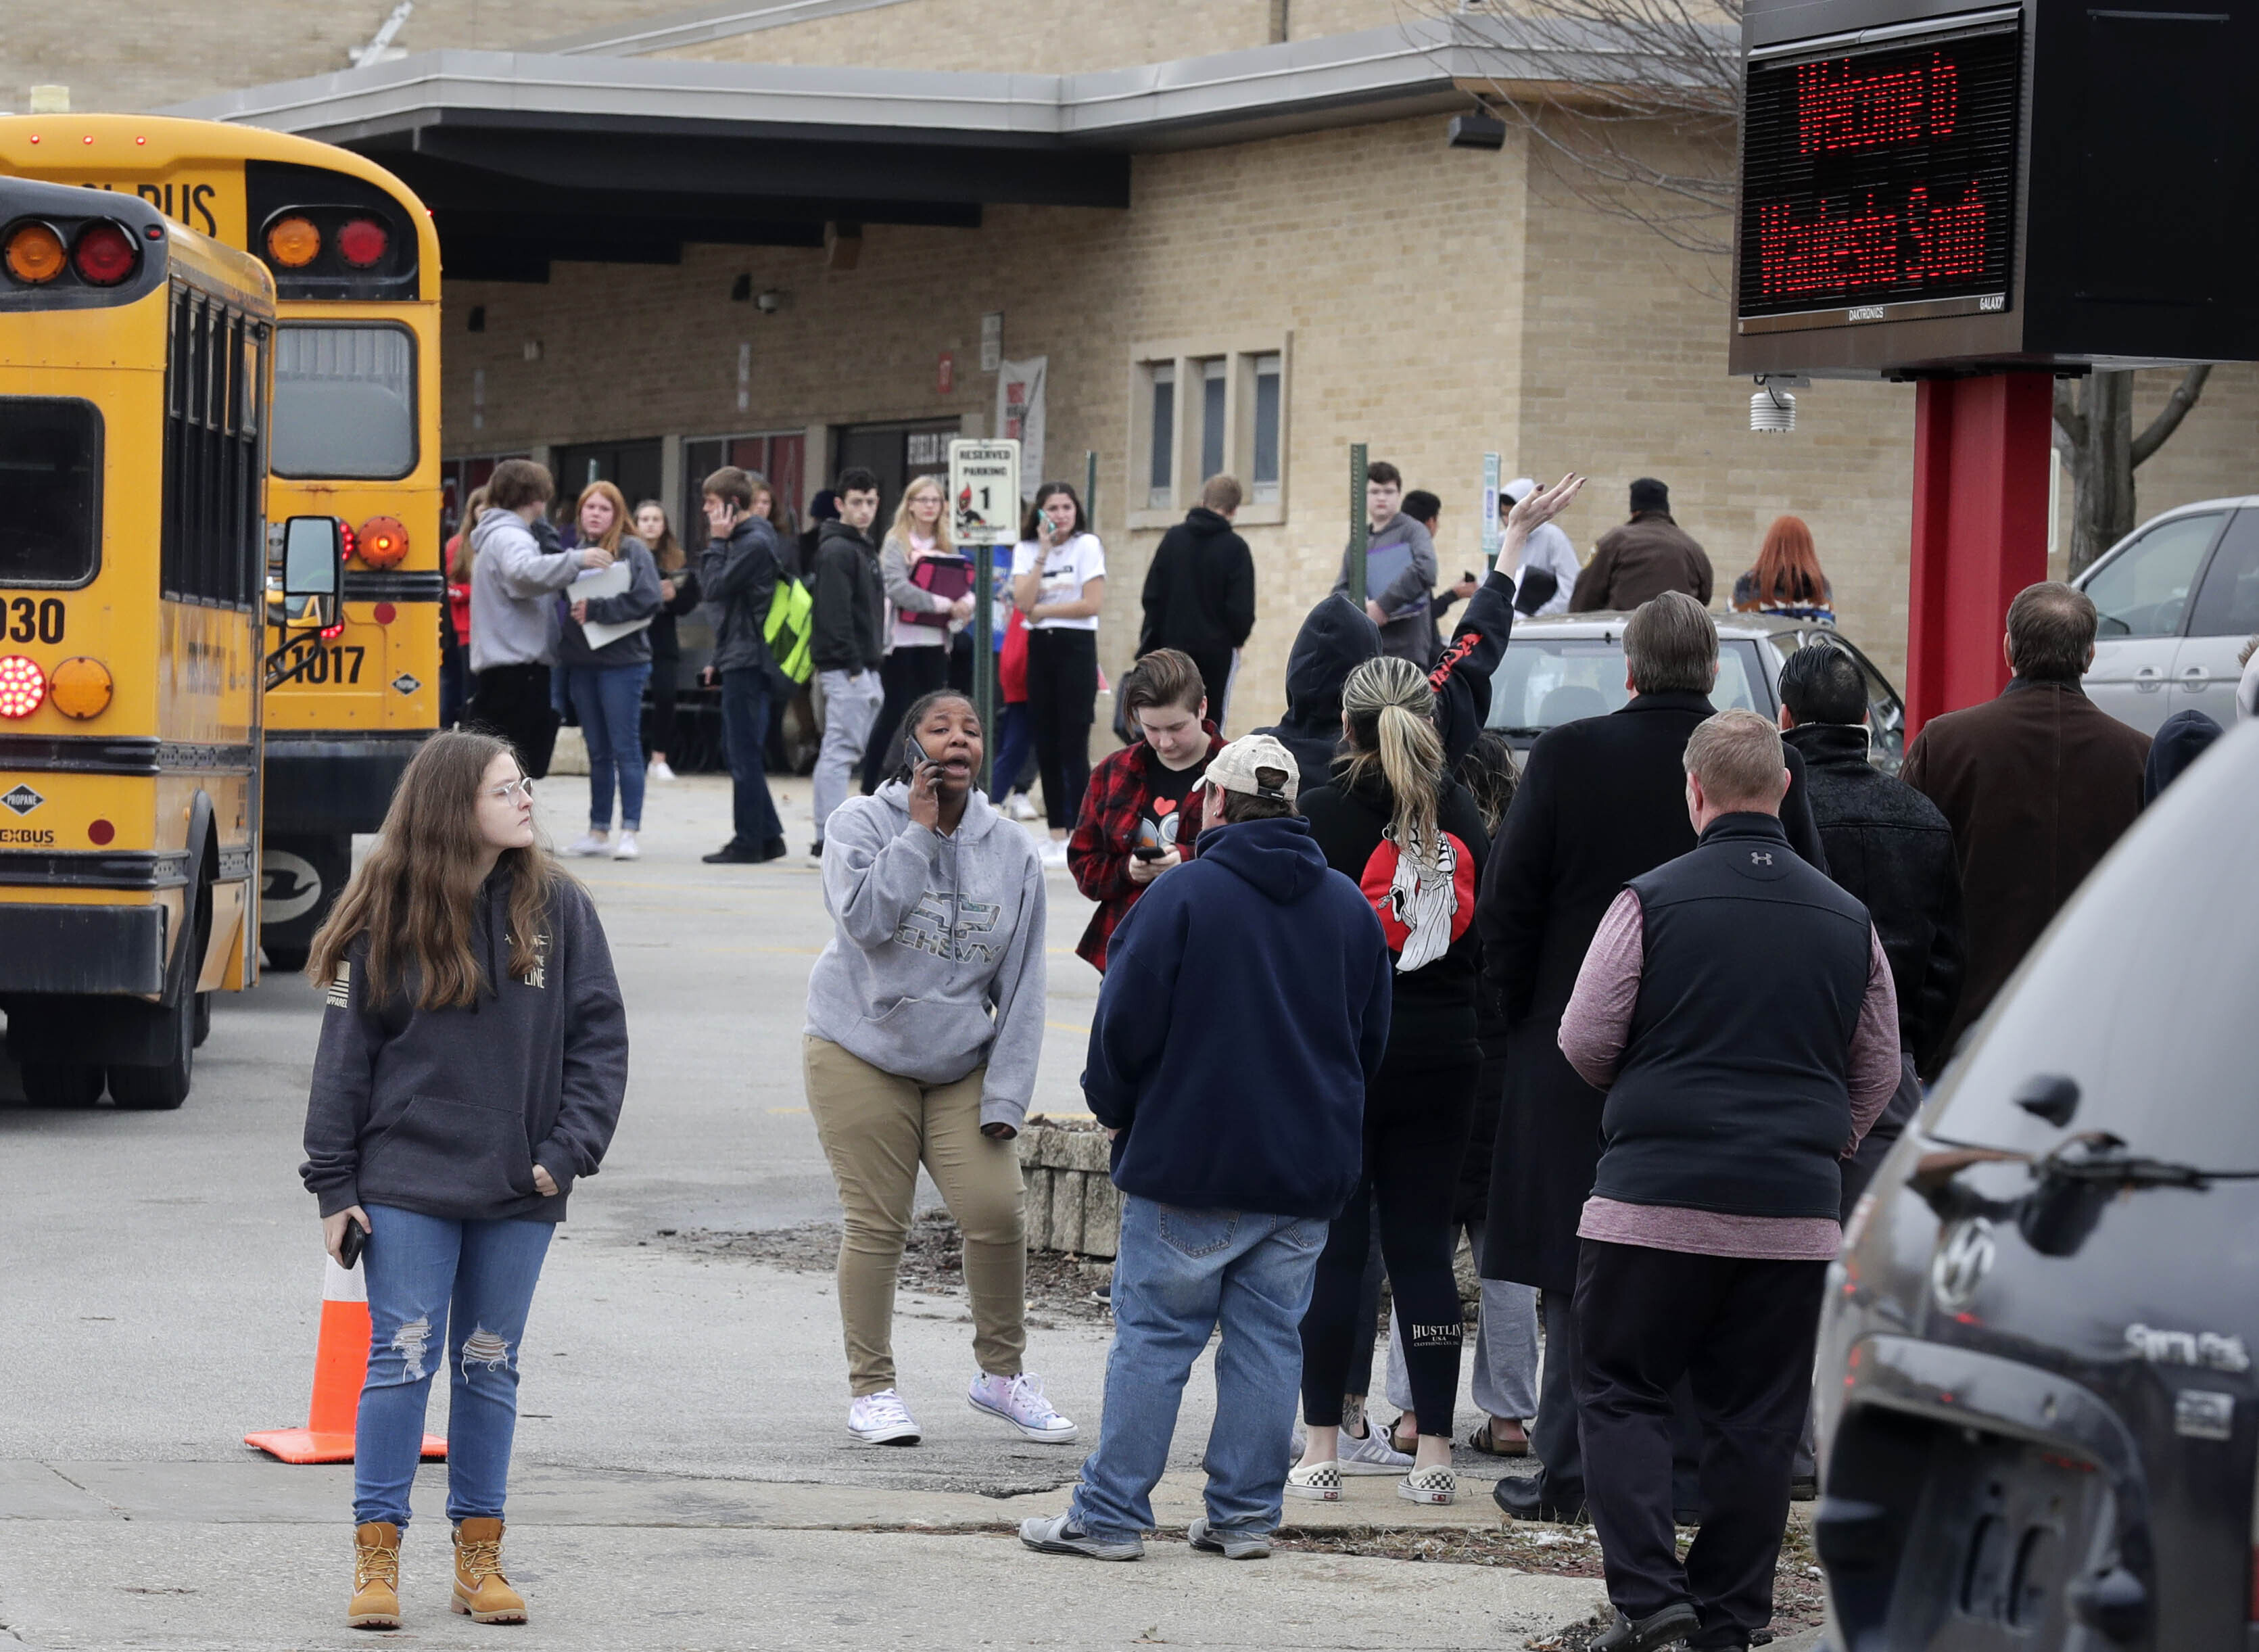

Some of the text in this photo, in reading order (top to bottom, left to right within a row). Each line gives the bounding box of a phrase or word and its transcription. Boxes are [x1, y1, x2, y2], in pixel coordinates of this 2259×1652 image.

[1798, 52, 1958, 154] Welcome to
[1905, 182, 1985, 280] South
[1849, 307, 1884, 321] DAKTRONICS
[959, 450, 1010, 460] RESERVED
[963, 467, 1007, 475] PARKING
[980, 487, 990, 509] 1
[0, 597, 65, 644] 30
[291, 646, 365, 684] 1017
[7, 794, 37, 806] PROPANE
[894, 924, 1002, 963] CHEVY
[525, 967, 545, 989] LINE
[327, 995, 348, 1008] APPAREL
